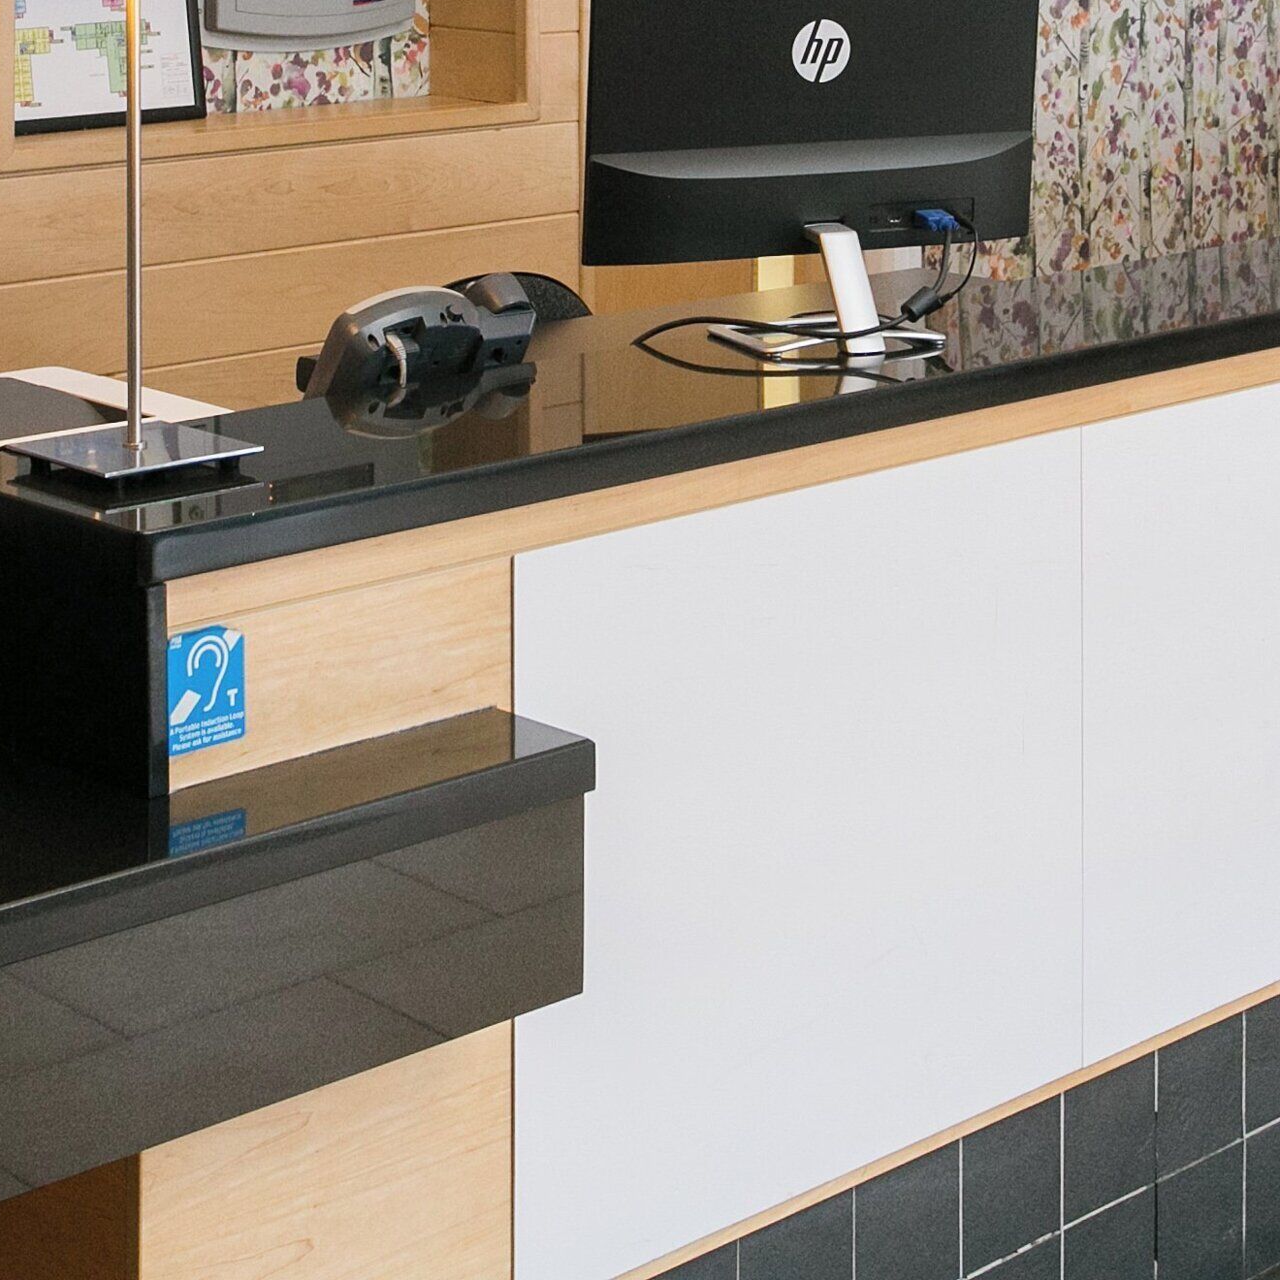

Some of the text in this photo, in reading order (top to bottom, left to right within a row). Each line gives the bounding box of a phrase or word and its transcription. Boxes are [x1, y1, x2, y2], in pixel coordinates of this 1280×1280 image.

[175, 722, 200, 734] Portable
[201, 714, 229, 726] Induction
[229, 711, 244, 720] Loop
[179, 730, 200, 742] System
[203, 735, 212, 743] for
